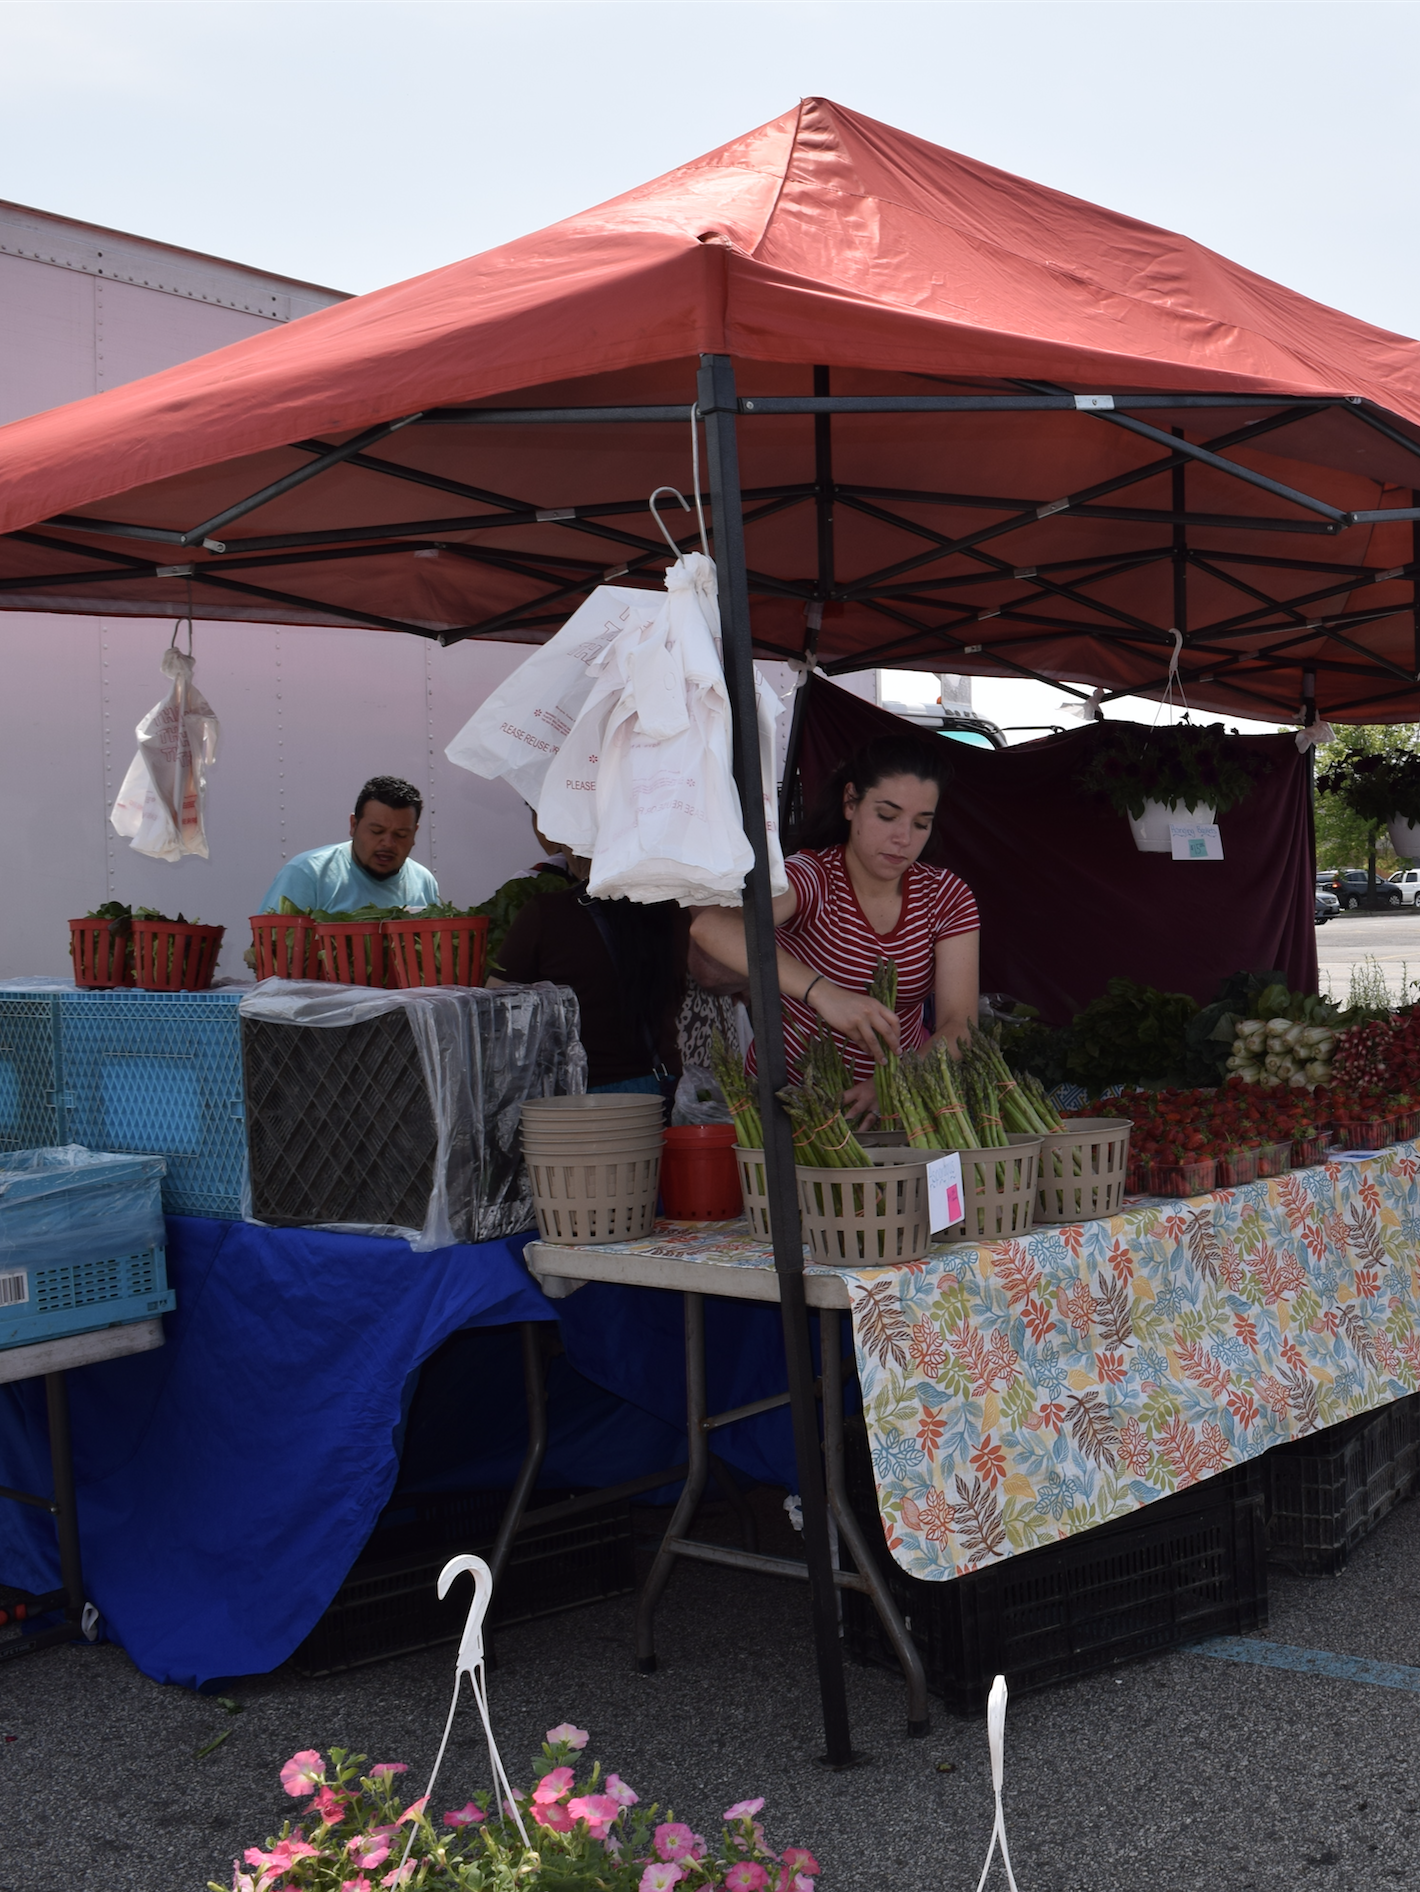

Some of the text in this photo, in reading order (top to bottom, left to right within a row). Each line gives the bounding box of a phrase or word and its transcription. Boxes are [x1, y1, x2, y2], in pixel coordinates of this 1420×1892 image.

[499, 722, 526, 740] PLEASE
[523, 733, 551, 753] REUSE
[566, 779, 596, 791] PLEASE
